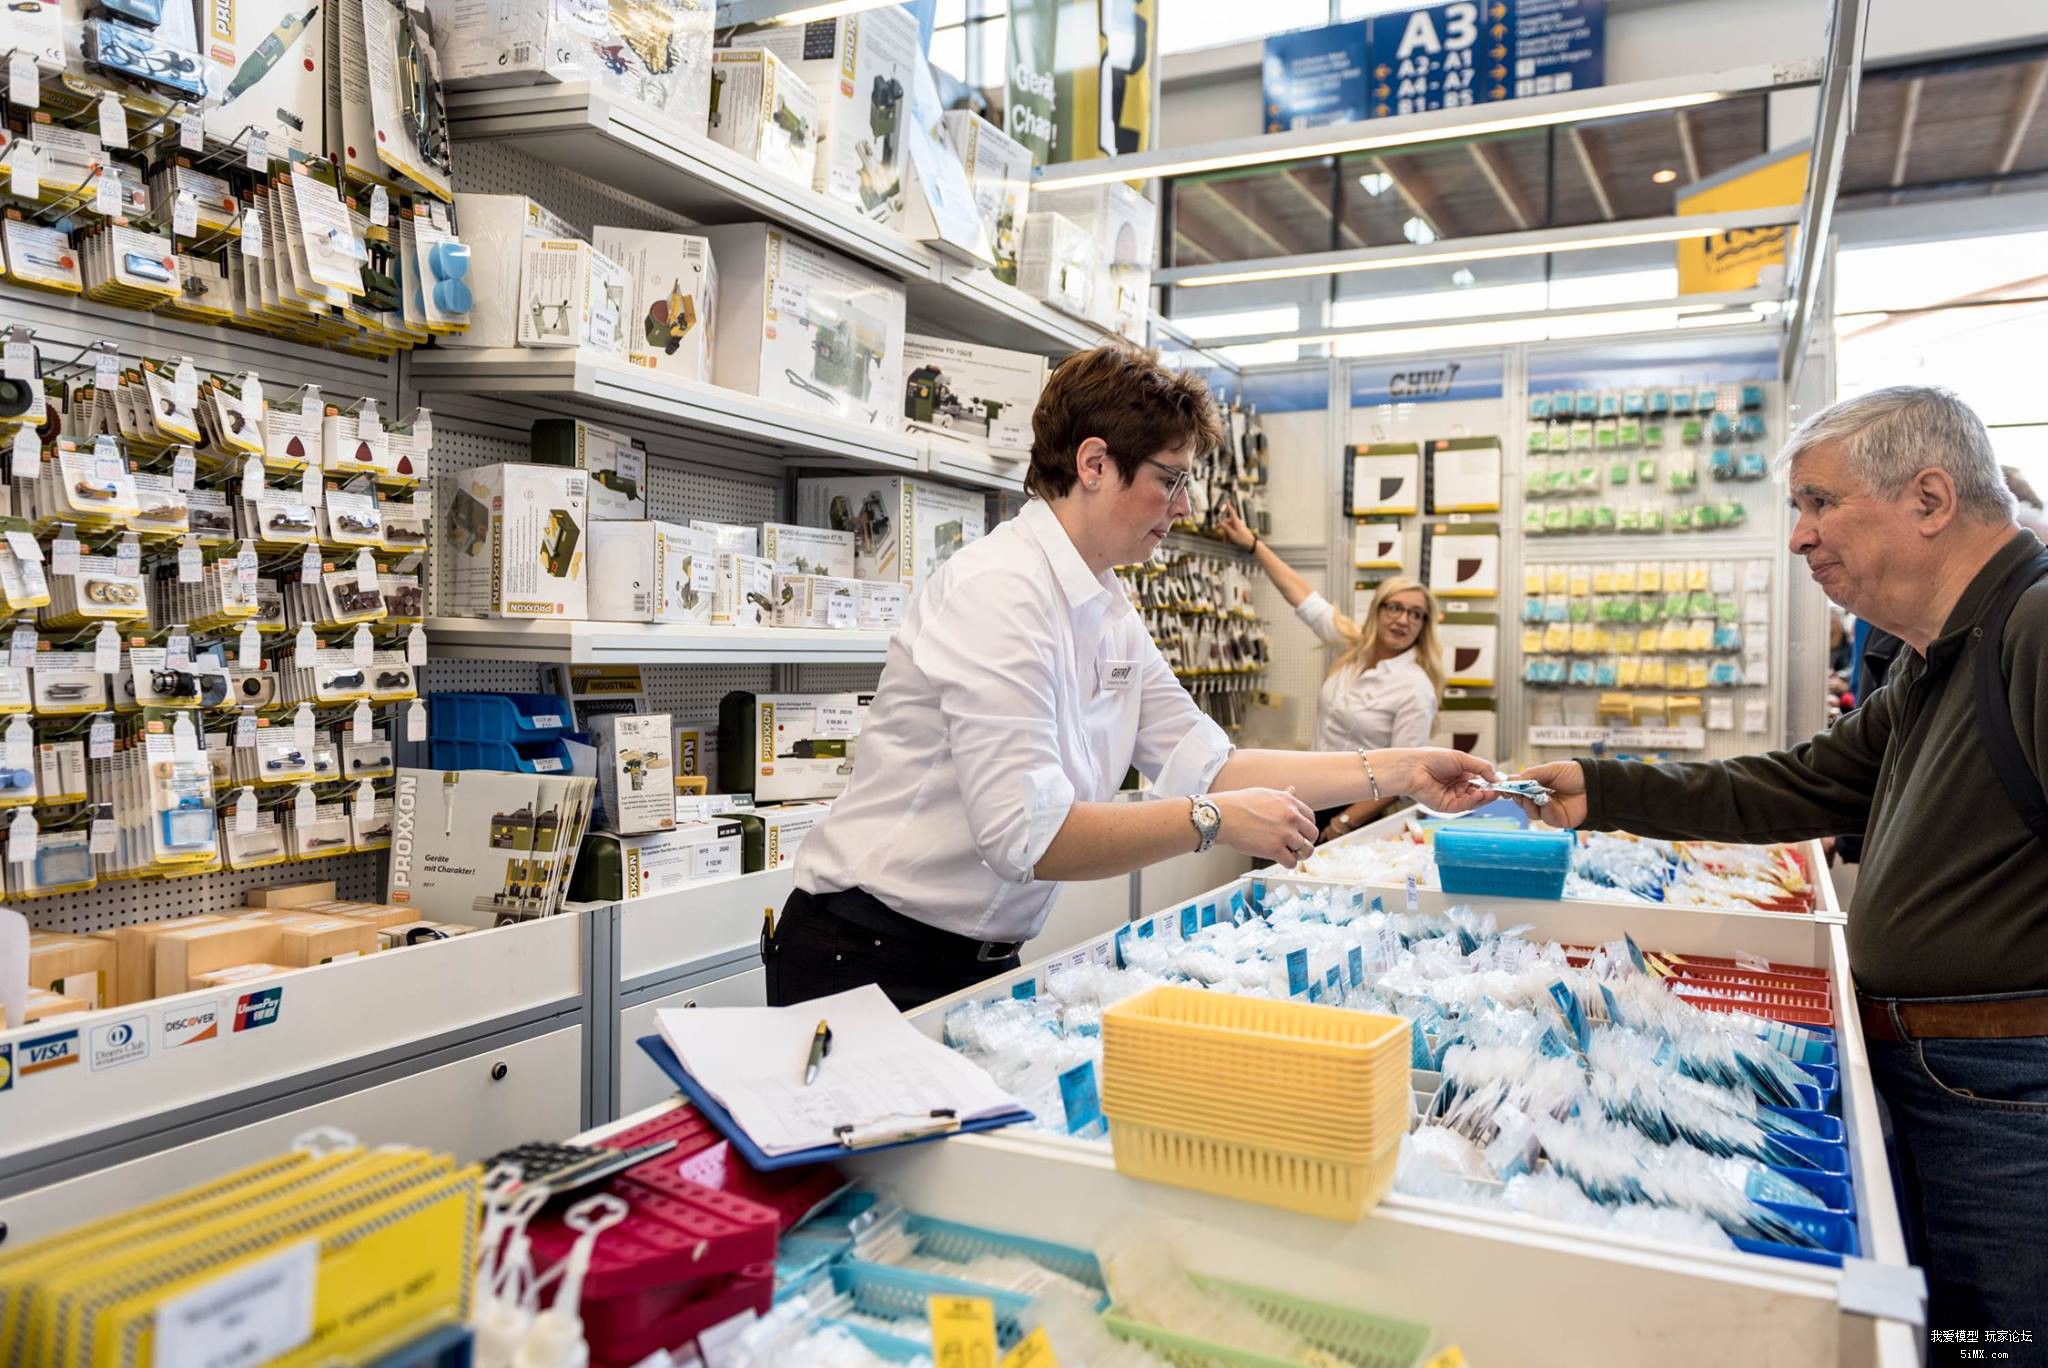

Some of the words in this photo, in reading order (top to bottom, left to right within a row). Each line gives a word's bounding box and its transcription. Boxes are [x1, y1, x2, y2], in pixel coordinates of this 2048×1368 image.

[1396, 2, 1478, 59] A3
[903, 495, 913, 569] PROXXON
[492, 522, 501, 604] PROXXON
[511, 604, 551, 612] PROXXON
[590, 681, 637, 690] INDUSTRIAL
[763, 707, 771, 759] PROXXON
[394, 776, 418, 887] PROXXON
[424, 854, 449, 863] Geräte
[437, 865, 476, 875] Charakter!
[629, 857, 638, 898] OXXON
[238, 998, 280, 1014] UnionPay
[165, 1012, 215, 1033] DISCOVER
[30, 1042, 68, 1062] VISA
